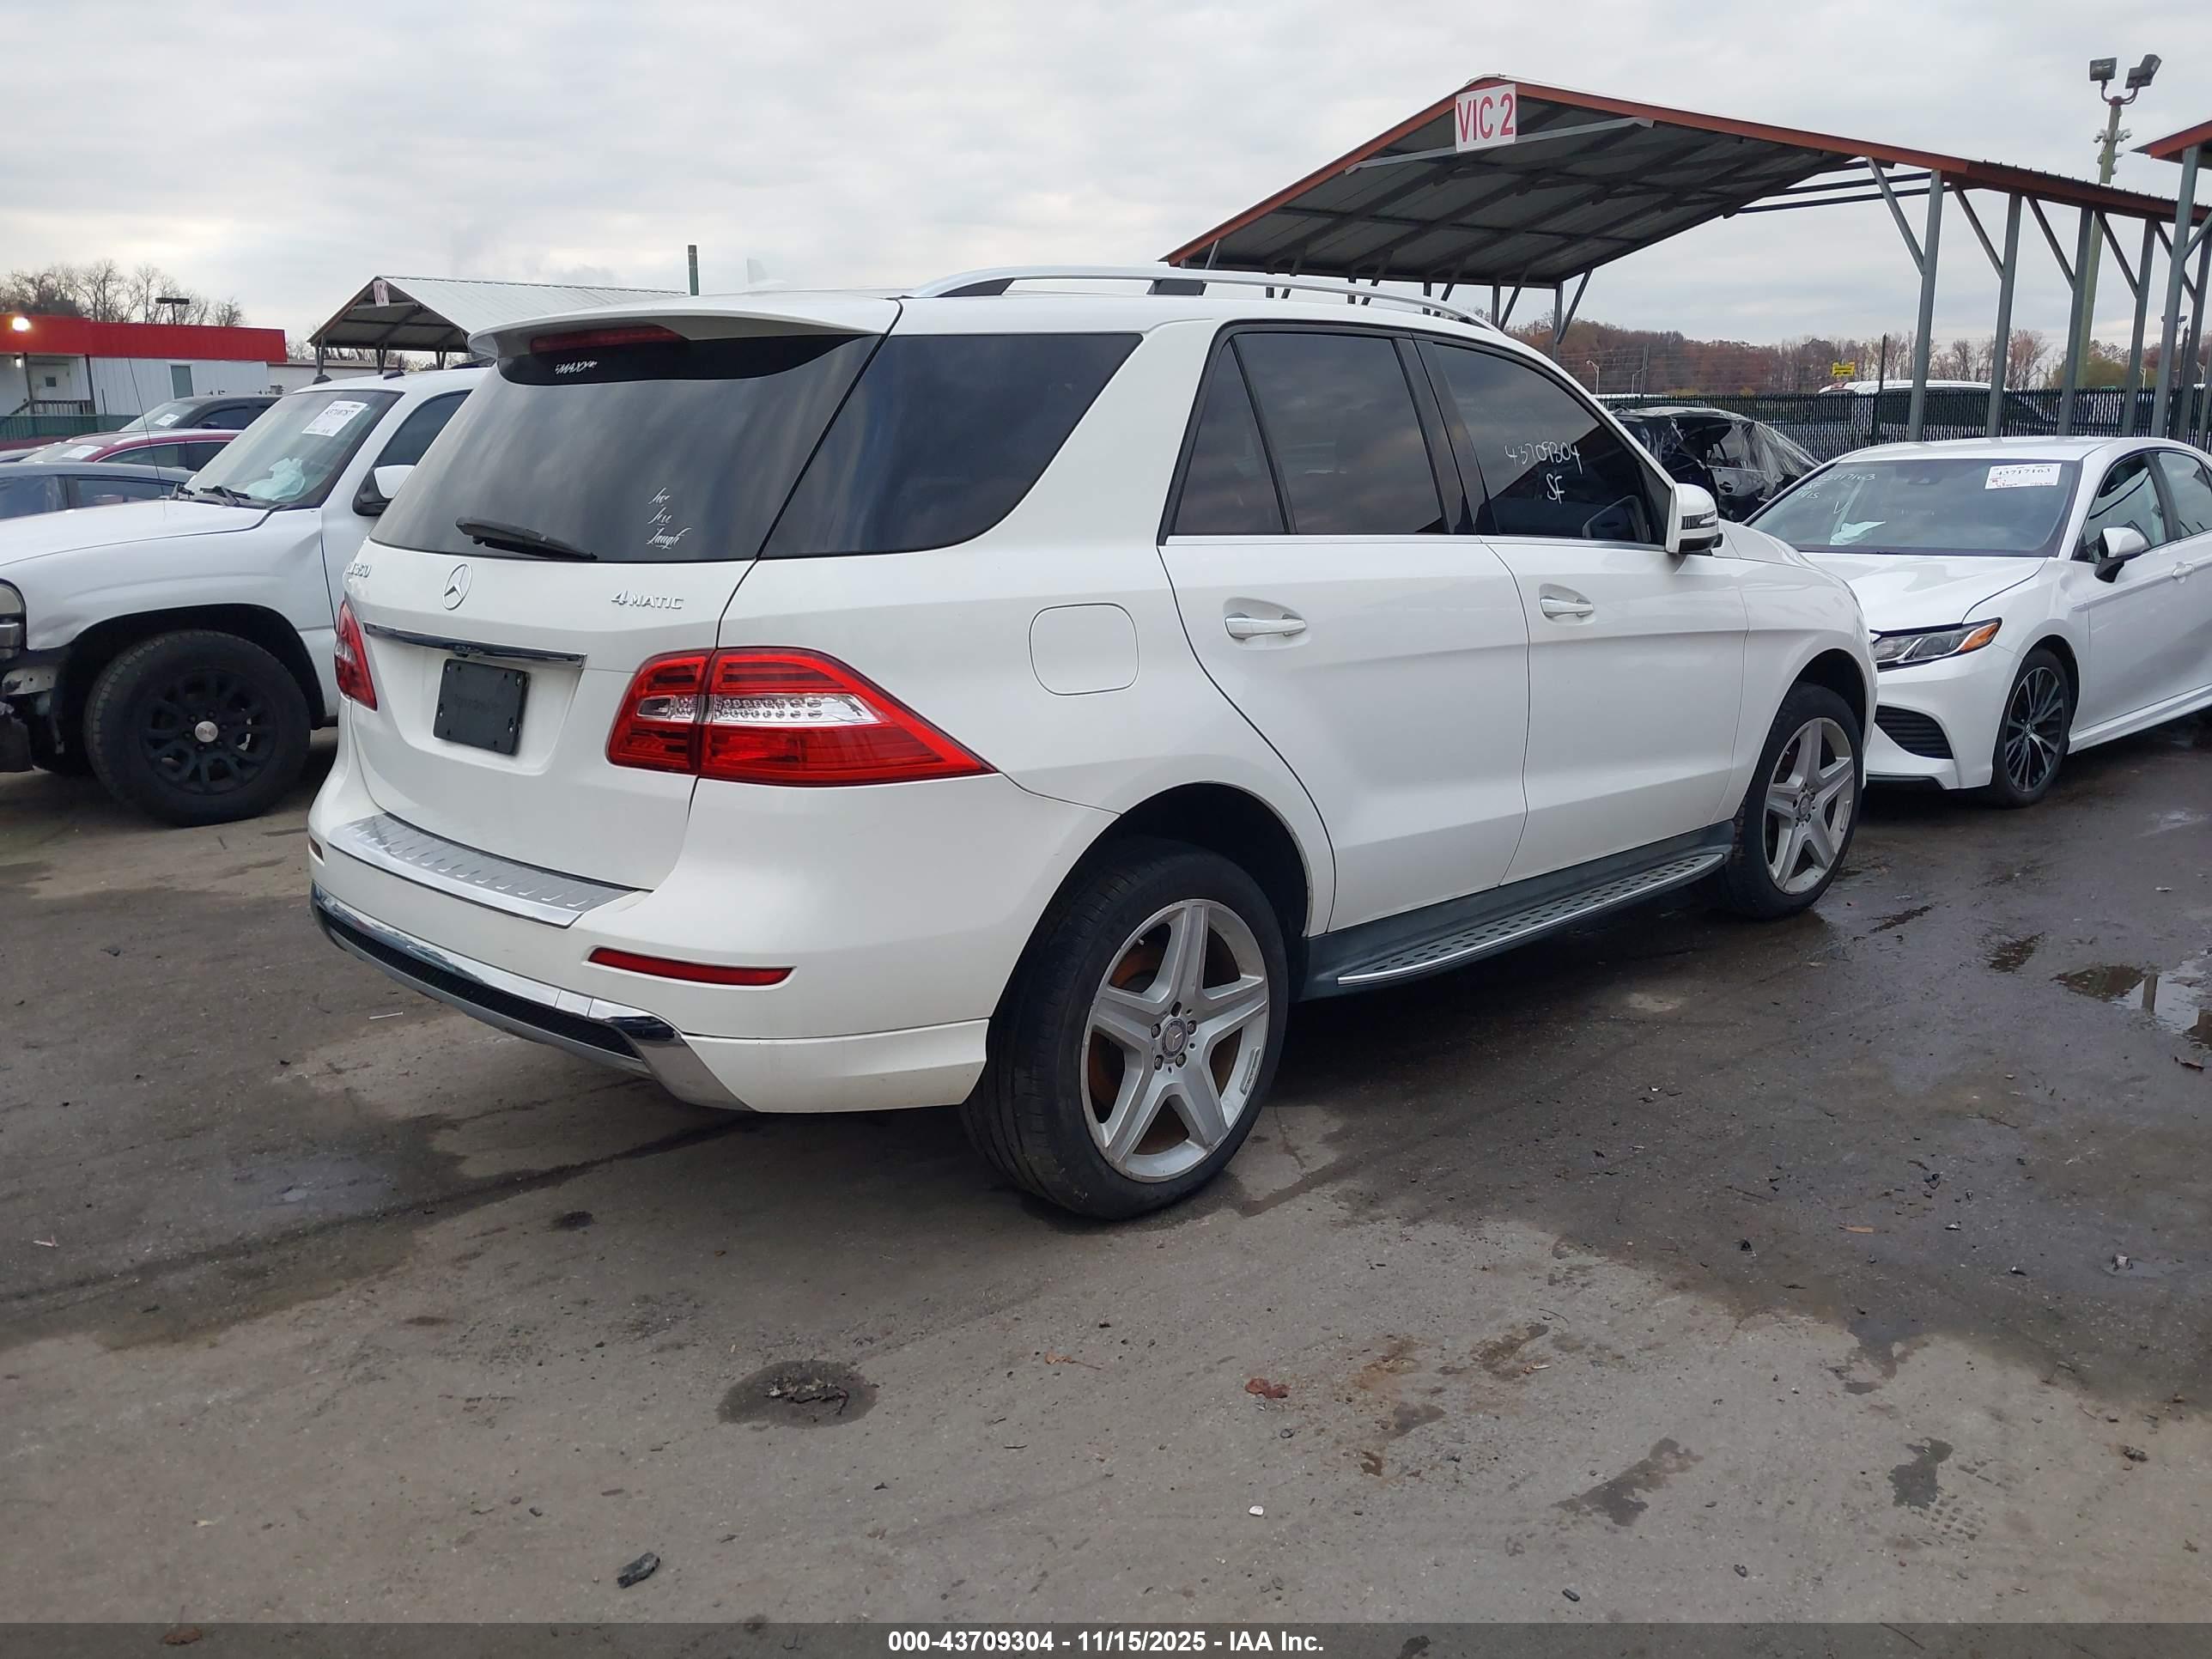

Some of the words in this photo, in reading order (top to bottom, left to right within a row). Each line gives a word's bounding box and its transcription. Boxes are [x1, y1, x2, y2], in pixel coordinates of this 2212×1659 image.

[1457, 95, 1494, 143] VIC
[1499, 93, 1514, 137] 2
[1504, 441, 1583, 475] 43709304
[1547, 473, 1565, 504] SF
